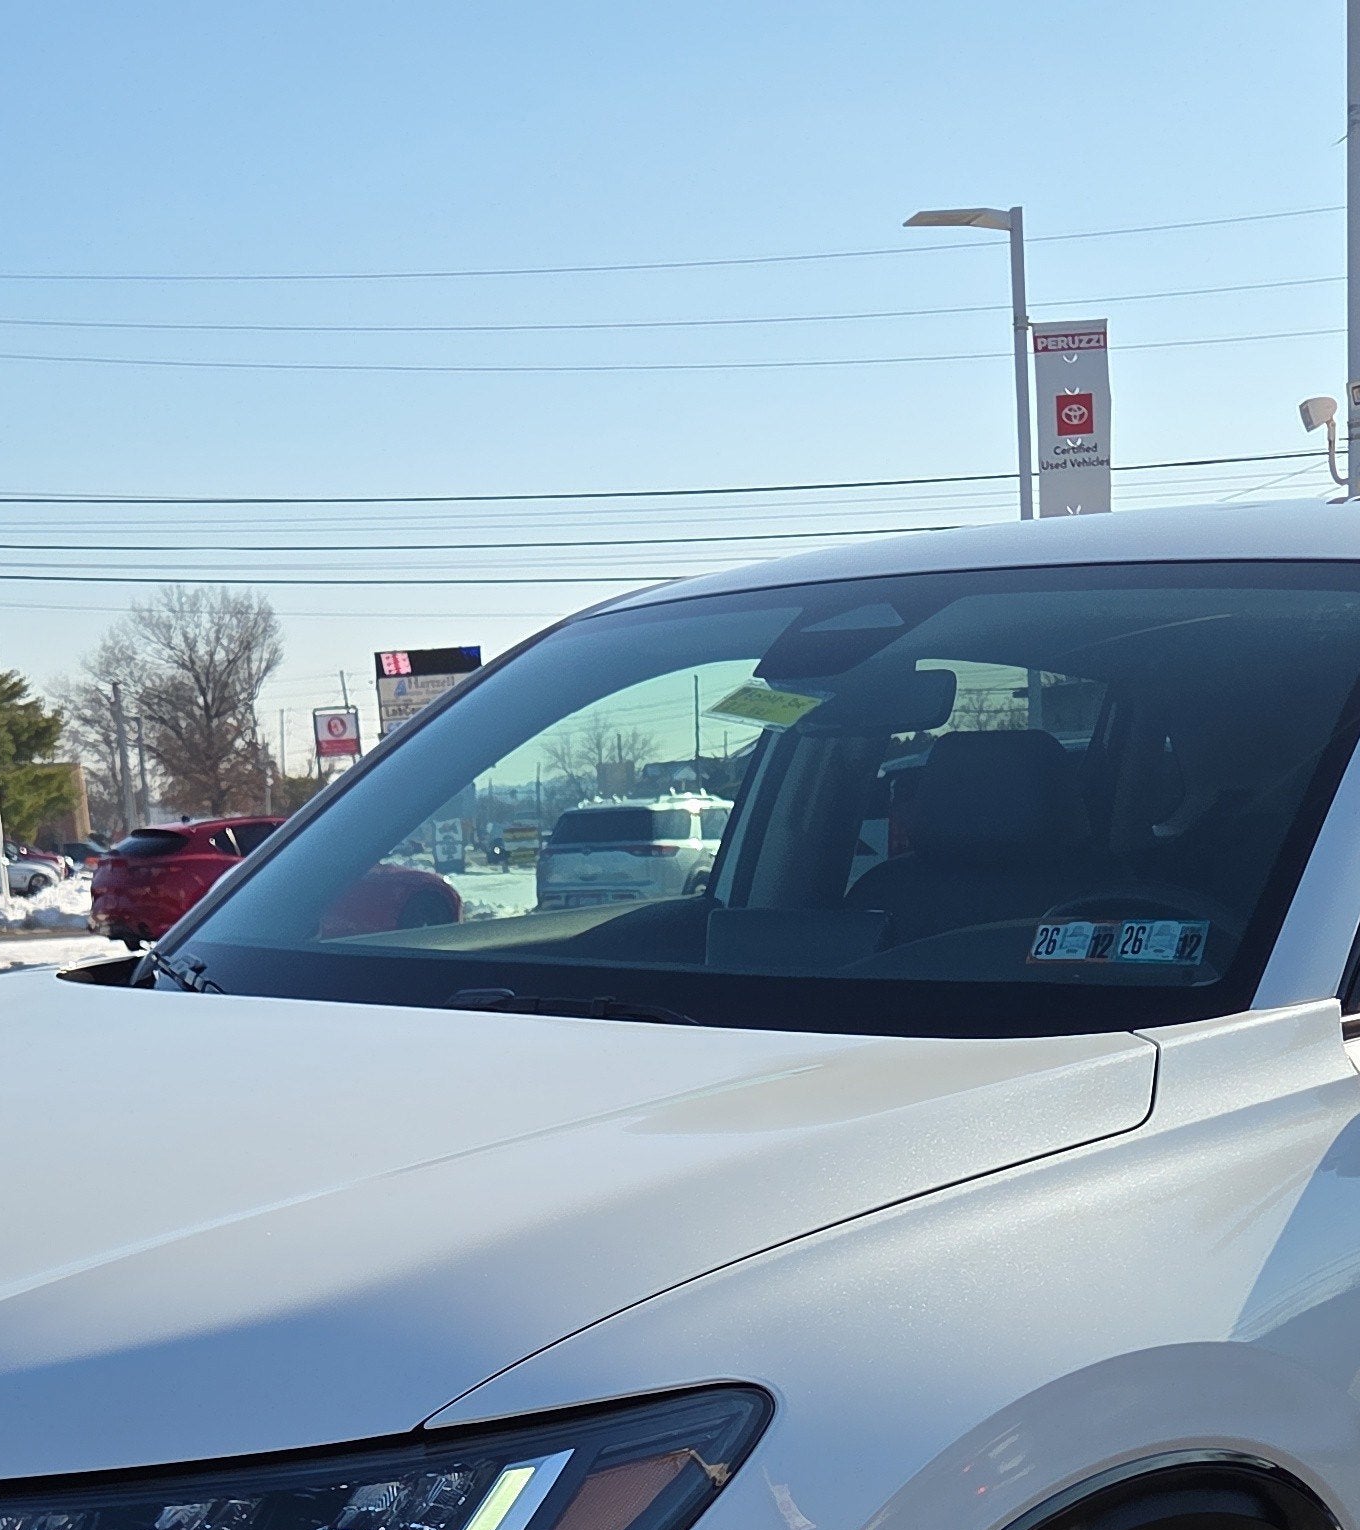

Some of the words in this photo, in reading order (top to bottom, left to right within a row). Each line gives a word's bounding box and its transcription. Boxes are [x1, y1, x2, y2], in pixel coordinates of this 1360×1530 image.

[1037, 334, 1104, 351] PERUZZI
[1041, 459, 1067, 470] Used
[1034, 927, 1061, 956] 26
[1089, 933, 1115, 959] 12
[1120, 925, 1147, 955] 26
